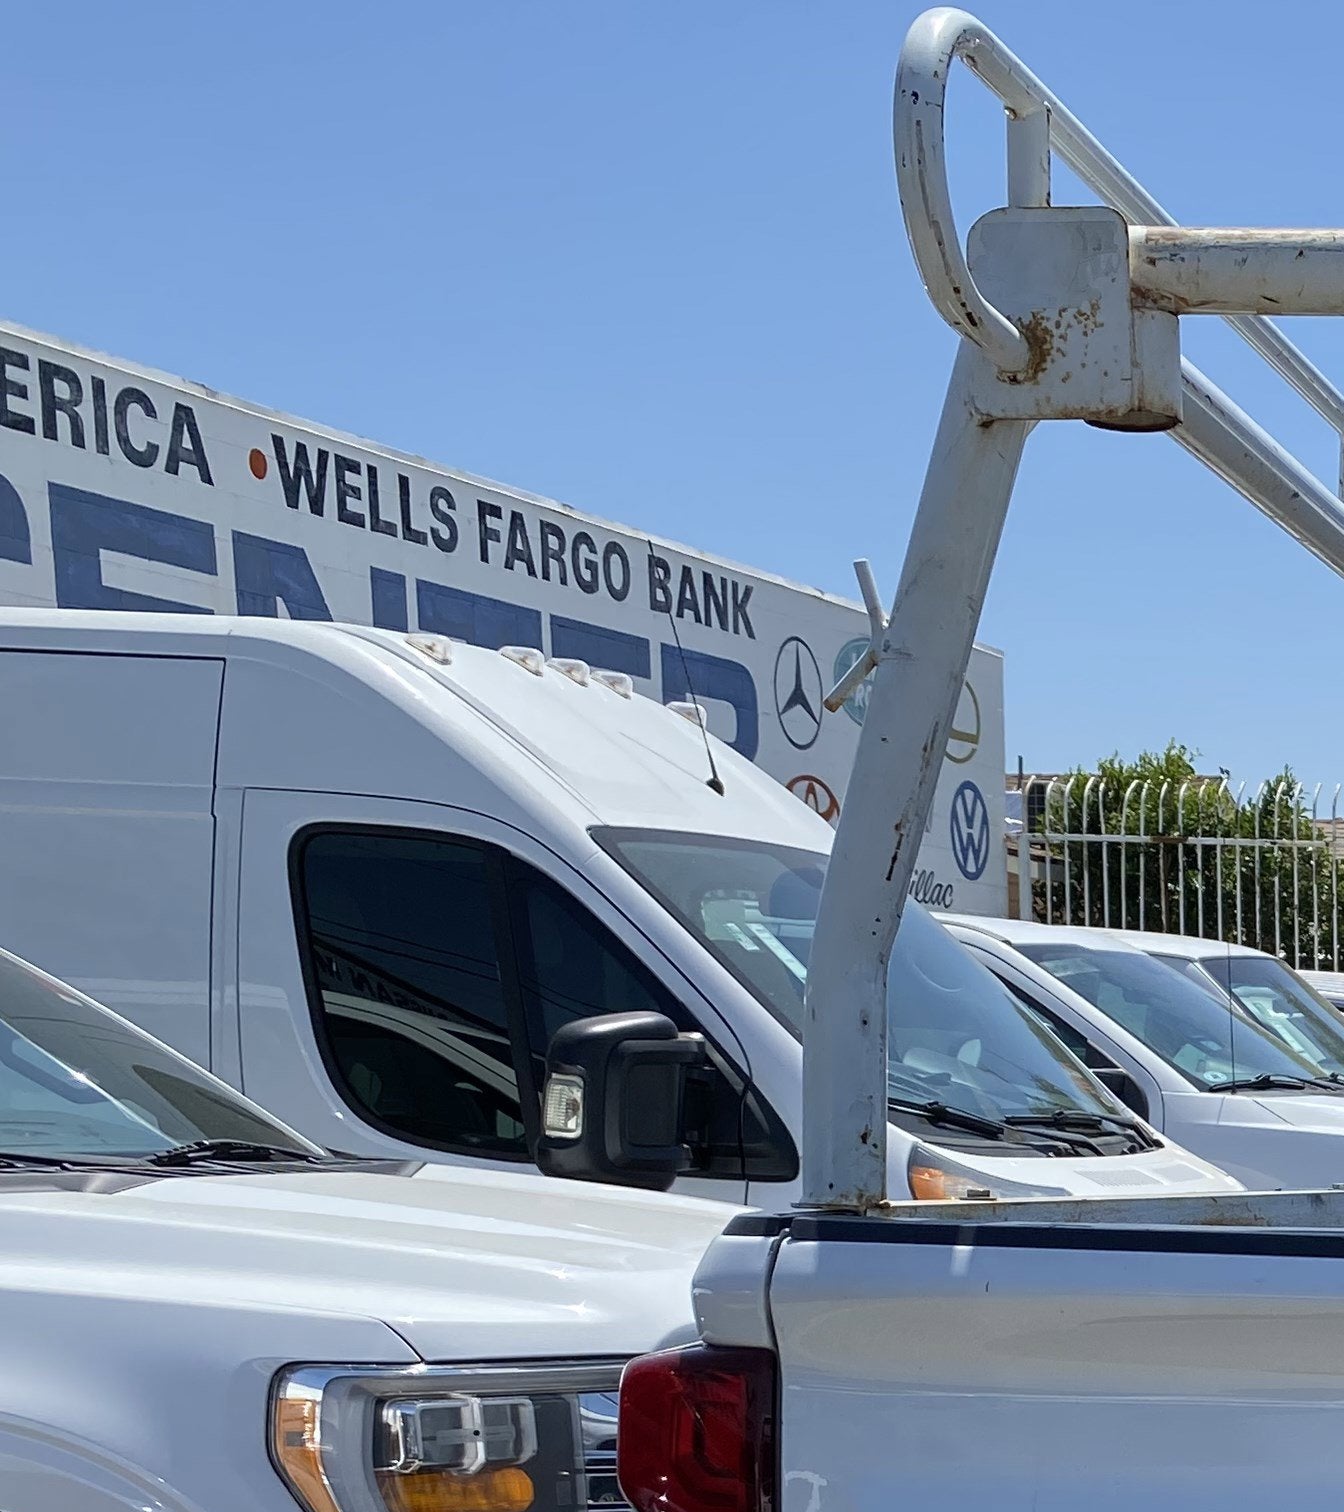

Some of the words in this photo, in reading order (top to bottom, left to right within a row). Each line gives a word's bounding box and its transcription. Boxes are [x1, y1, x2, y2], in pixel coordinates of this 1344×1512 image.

[271, 433, 460, 554] WELLS
[476, 499, 631, 602] FARGO
[649, 555, 757, 640] BANK
